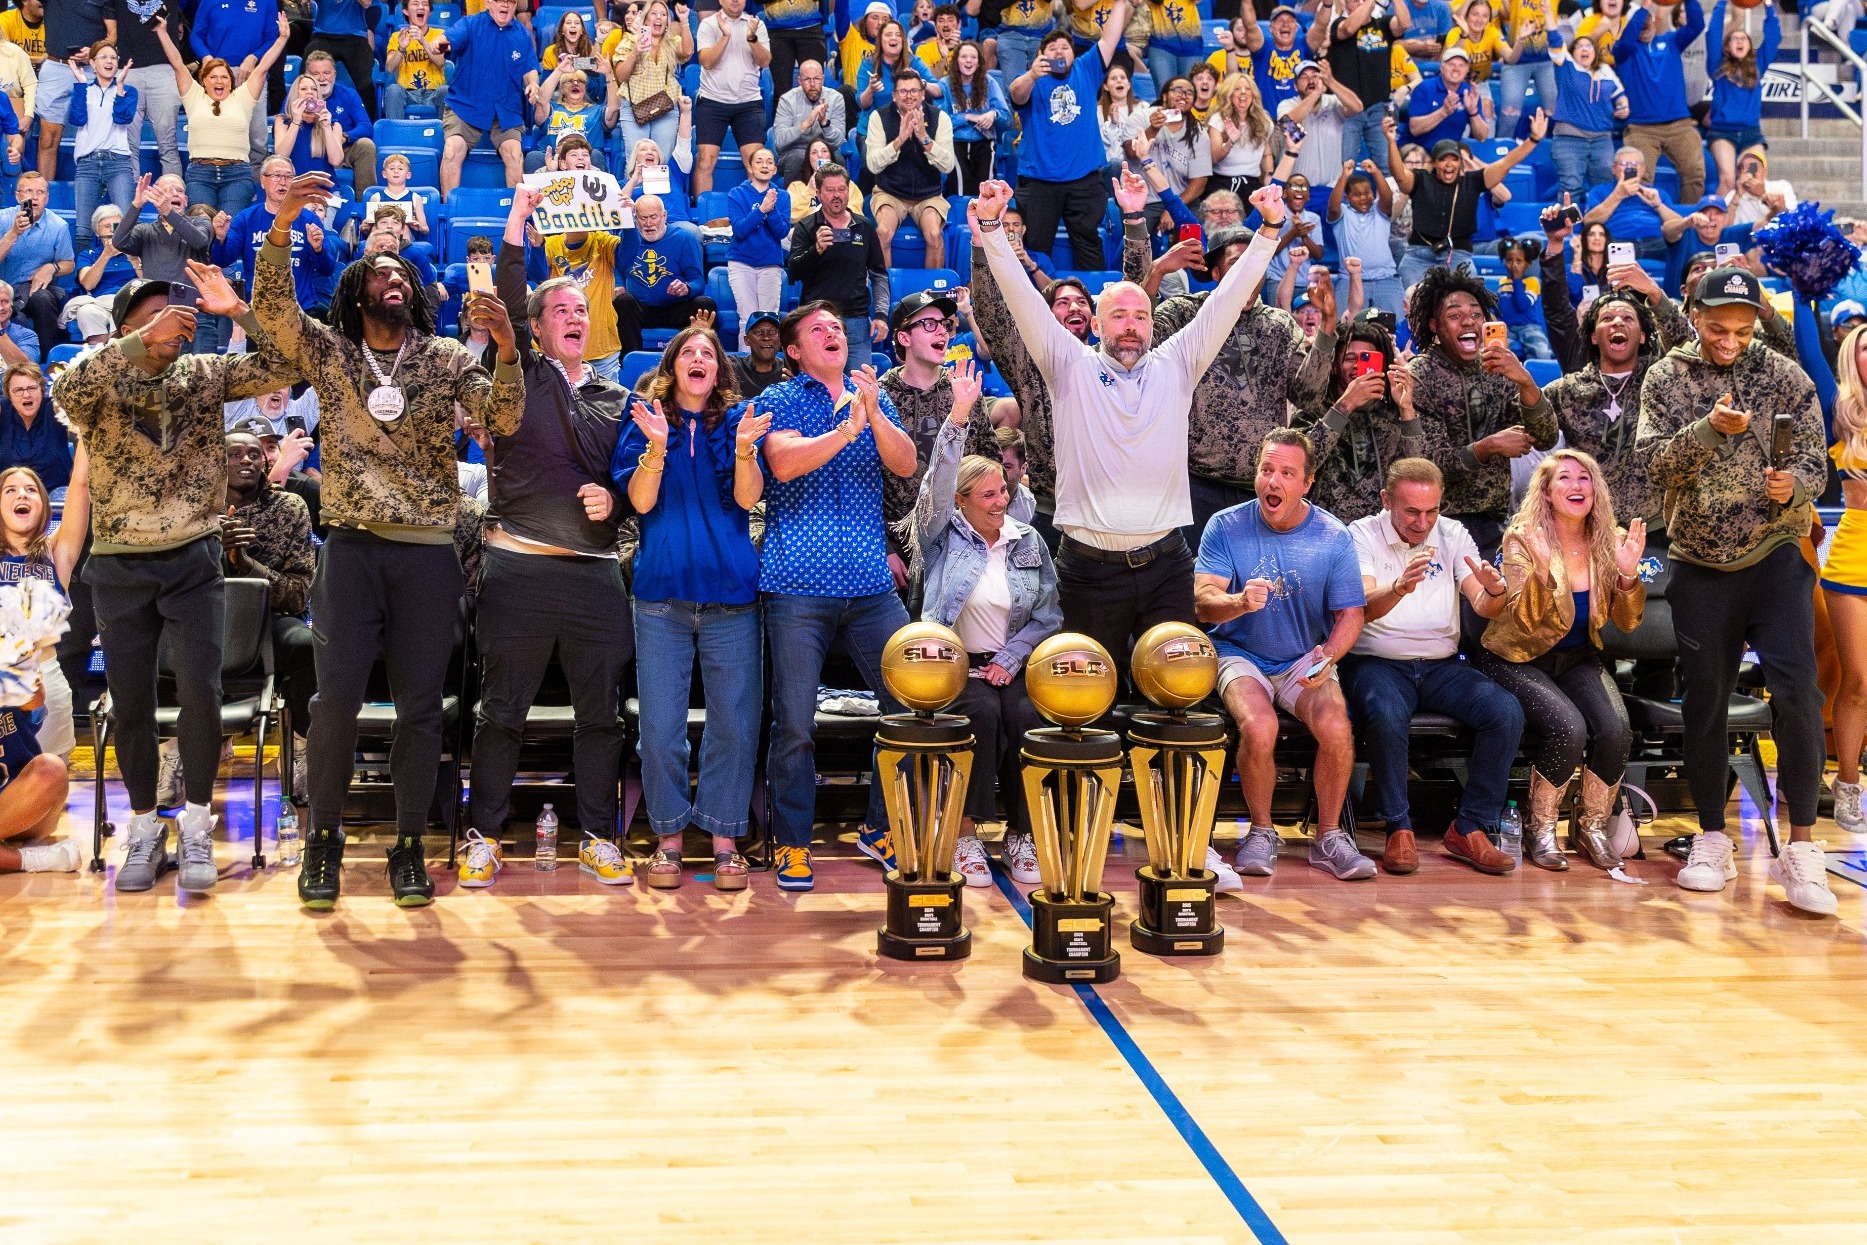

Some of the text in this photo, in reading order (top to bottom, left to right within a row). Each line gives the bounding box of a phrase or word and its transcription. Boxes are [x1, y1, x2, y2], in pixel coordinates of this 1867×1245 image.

[541, 177, 575, 197] owboy
[535, 201, 621, 231] Bandits
[1724, 285, 1749, 296] CHAMPS
